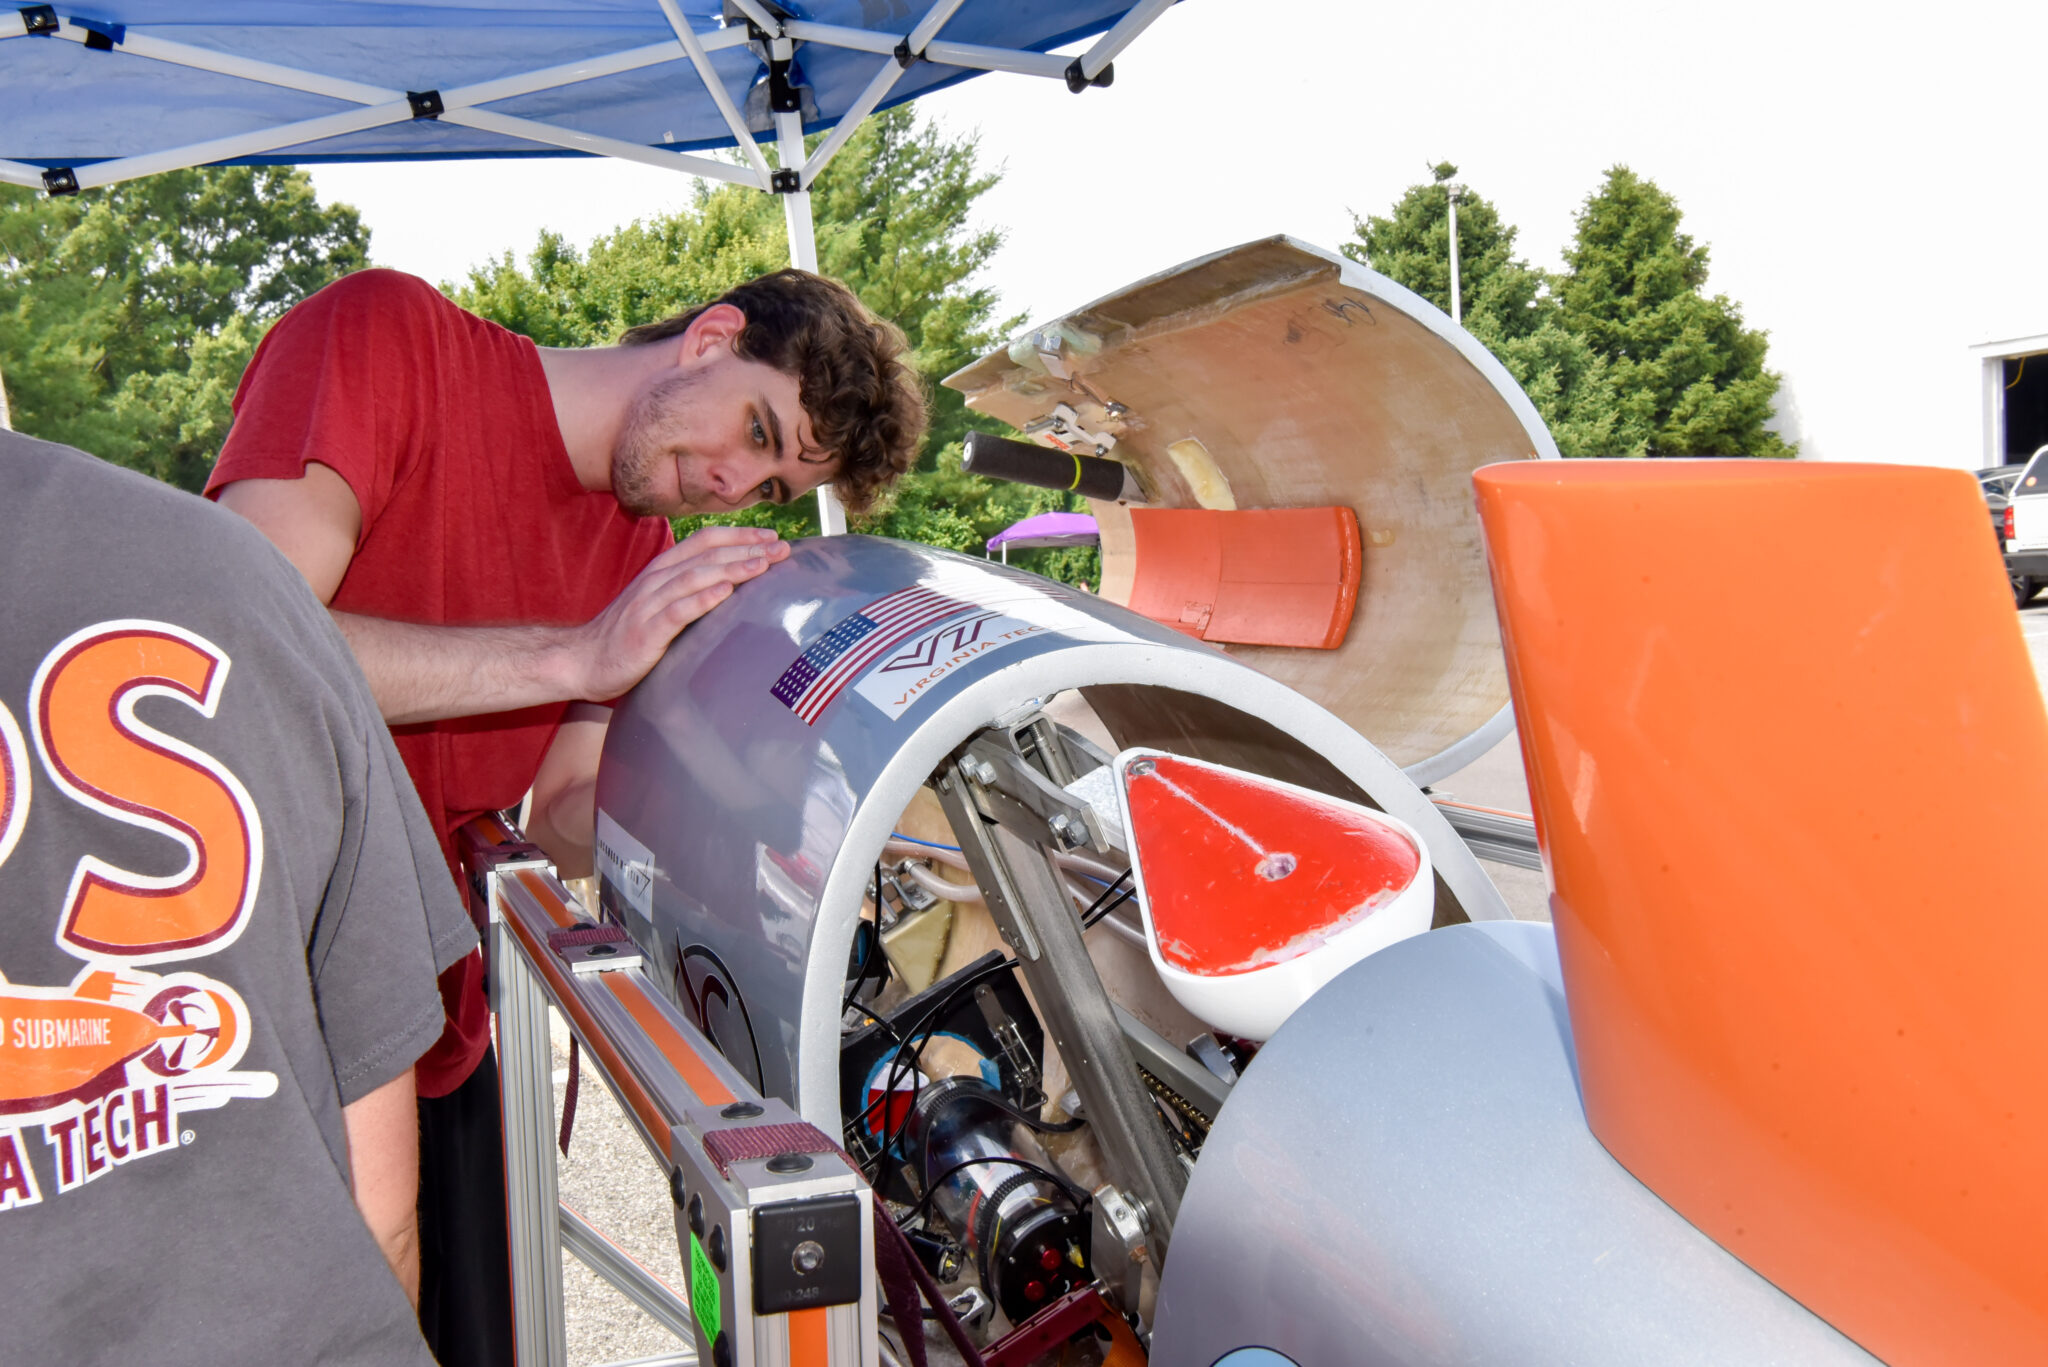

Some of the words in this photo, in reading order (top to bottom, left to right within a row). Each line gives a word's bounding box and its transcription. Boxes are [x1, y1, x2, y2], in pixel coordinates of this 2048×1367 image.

[893, 641, 997, 705] VIRGINIA
[998, 625, 1046, 641] TEC
[13, 1018, 112, 1049] SUBMARINE
[49, 1082, 171, 1187] TECH
